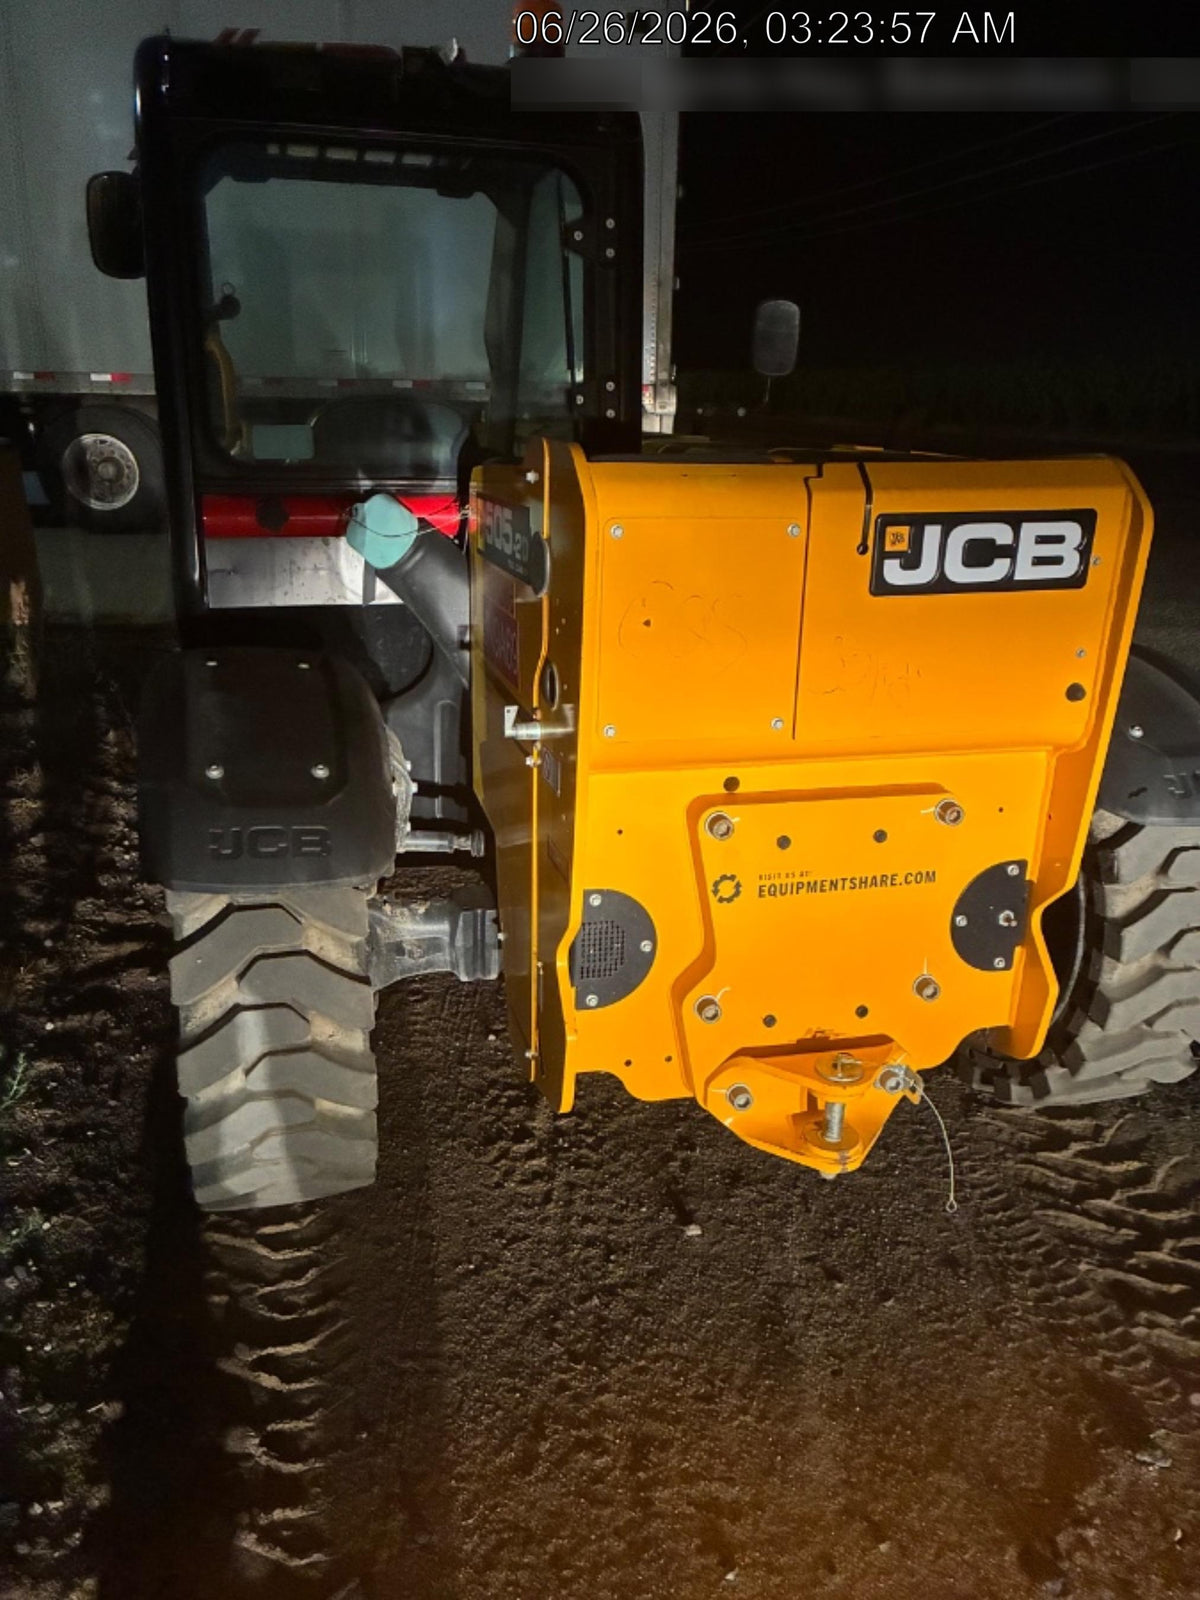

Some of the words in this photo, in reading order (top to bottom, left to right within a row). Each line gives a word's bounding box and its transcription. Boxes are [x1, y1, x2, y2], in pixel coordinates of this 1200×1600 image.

[883, 521, 1082, 585] JCB
[208, 825, 332, 860] JCB
[757, 870, 937, 898] EQUIPMENTSHARE.COM
